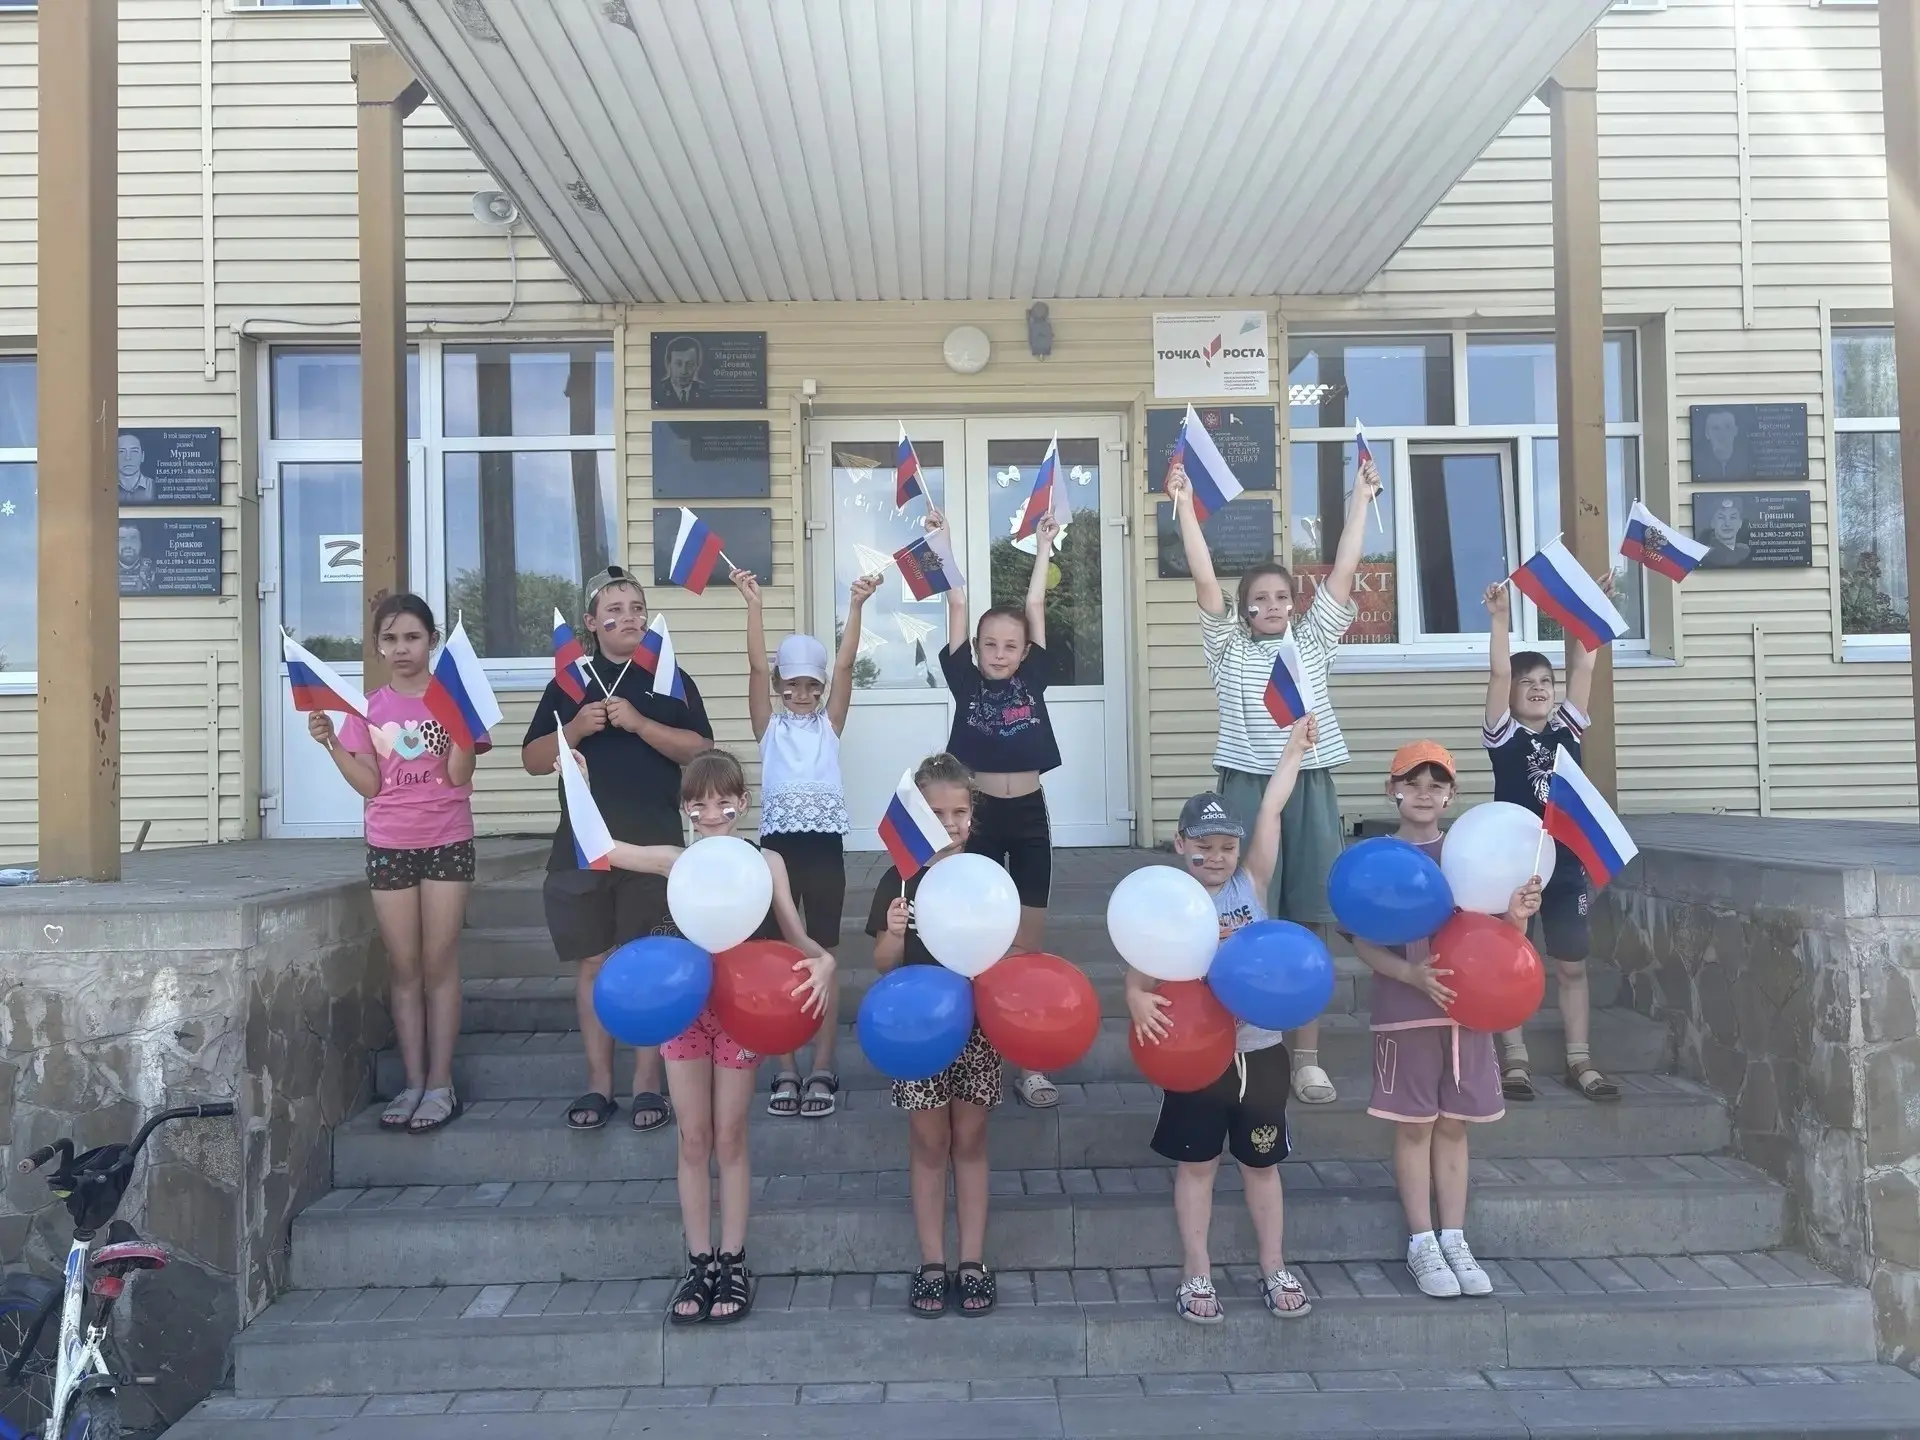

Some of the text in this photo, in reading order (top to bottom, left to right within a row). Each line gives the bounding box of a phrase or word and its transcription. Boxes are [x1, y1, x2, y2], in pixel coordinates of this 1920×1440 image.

[1157, 348, 1265, 360] ТОЧКА РОСТА
[170, 449, 201, 460] Мурзин
[1228, 447, 1260, 455] СРЕДНЯЯ
[169, 539, 203, 550] Ермаков
[324, 540, 363, 568] Z
[396, 768, 432, 786] love
[1200, 812, 1227, 821] adidas
